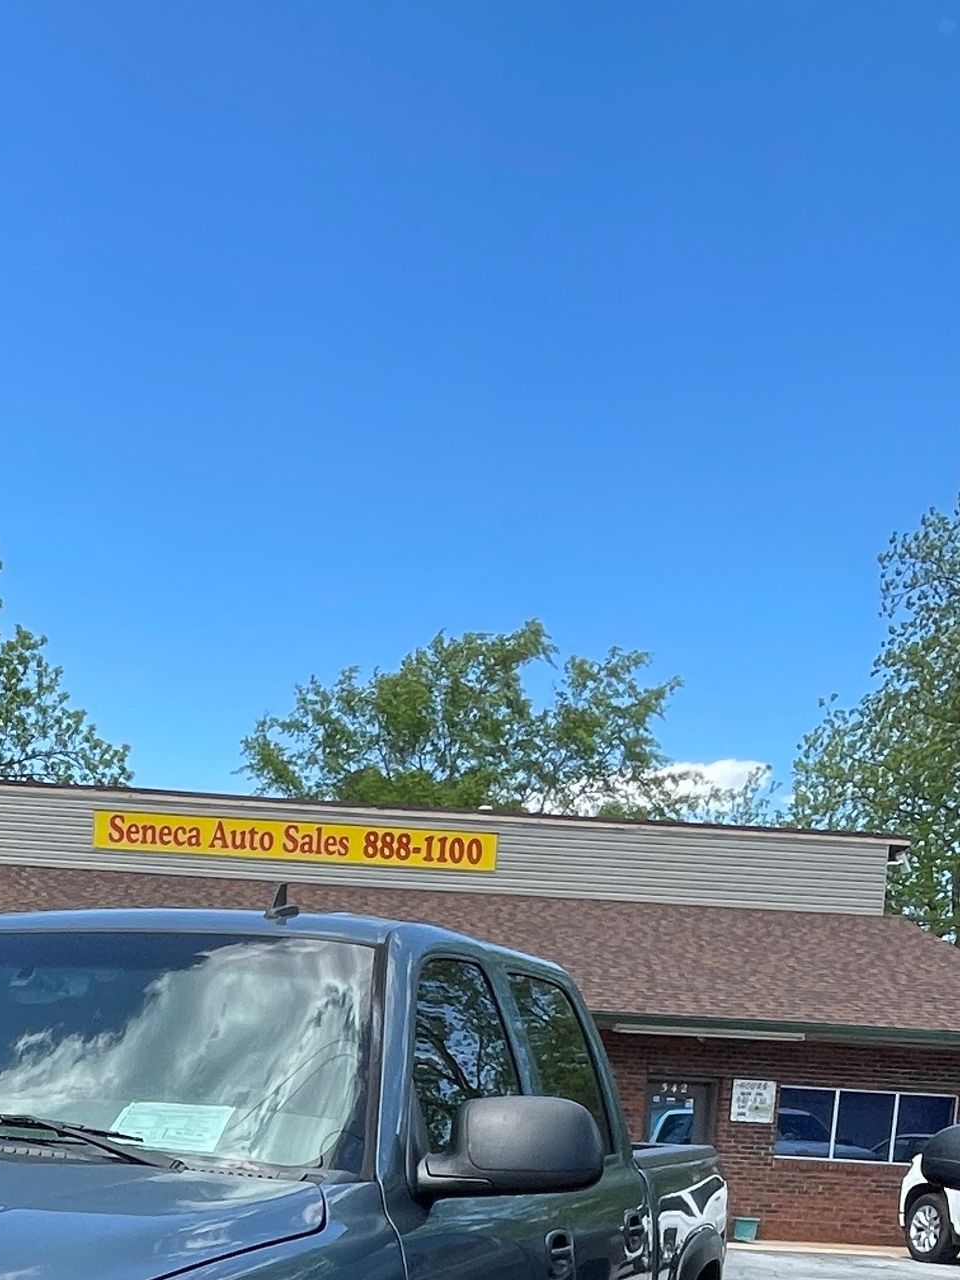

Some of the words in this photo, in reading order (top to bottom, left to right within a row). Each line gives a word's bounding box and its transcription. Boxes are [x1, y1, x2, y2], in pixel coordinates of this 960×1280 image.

[108, 814, 202, 847] Seneca
[209, 820, 275, 851] Auto
[283, 825, 350, 857] Sales
[363, 830, 483, 865] 888-1100
[661, 1082, 688, 1094] 542
